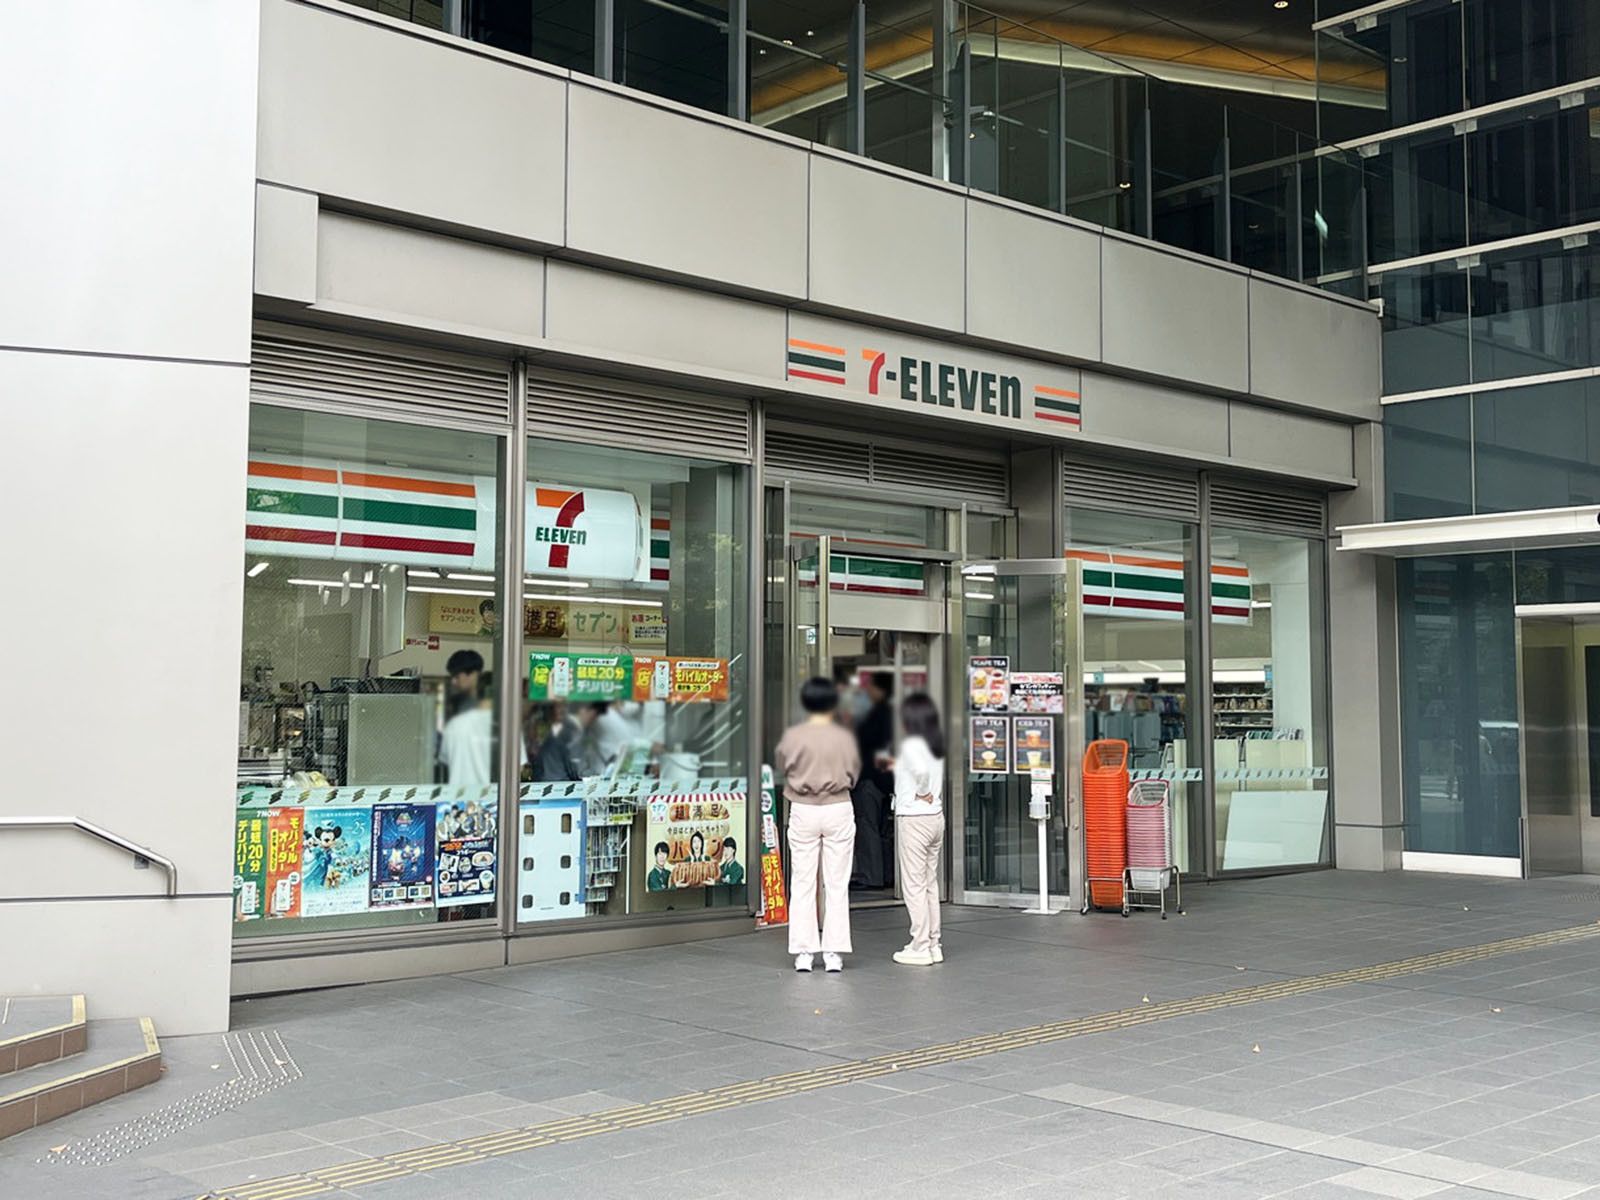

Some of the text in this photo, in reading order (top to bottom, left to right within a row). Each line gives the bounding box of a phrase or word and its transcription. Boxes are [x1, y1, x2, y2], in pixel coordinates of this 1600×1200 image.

[573, 610, 617, 632] セブン
[675, 669, 724, 683] モバイルオーダー
[236, 820, 248, 874] デリバリー
[278, 831, 289, 871] オーダー
[287, 817, 300, 864] モバイル
[765, 875, 776, 920] オーダー
[771, 856, 785, 907] モバイル
